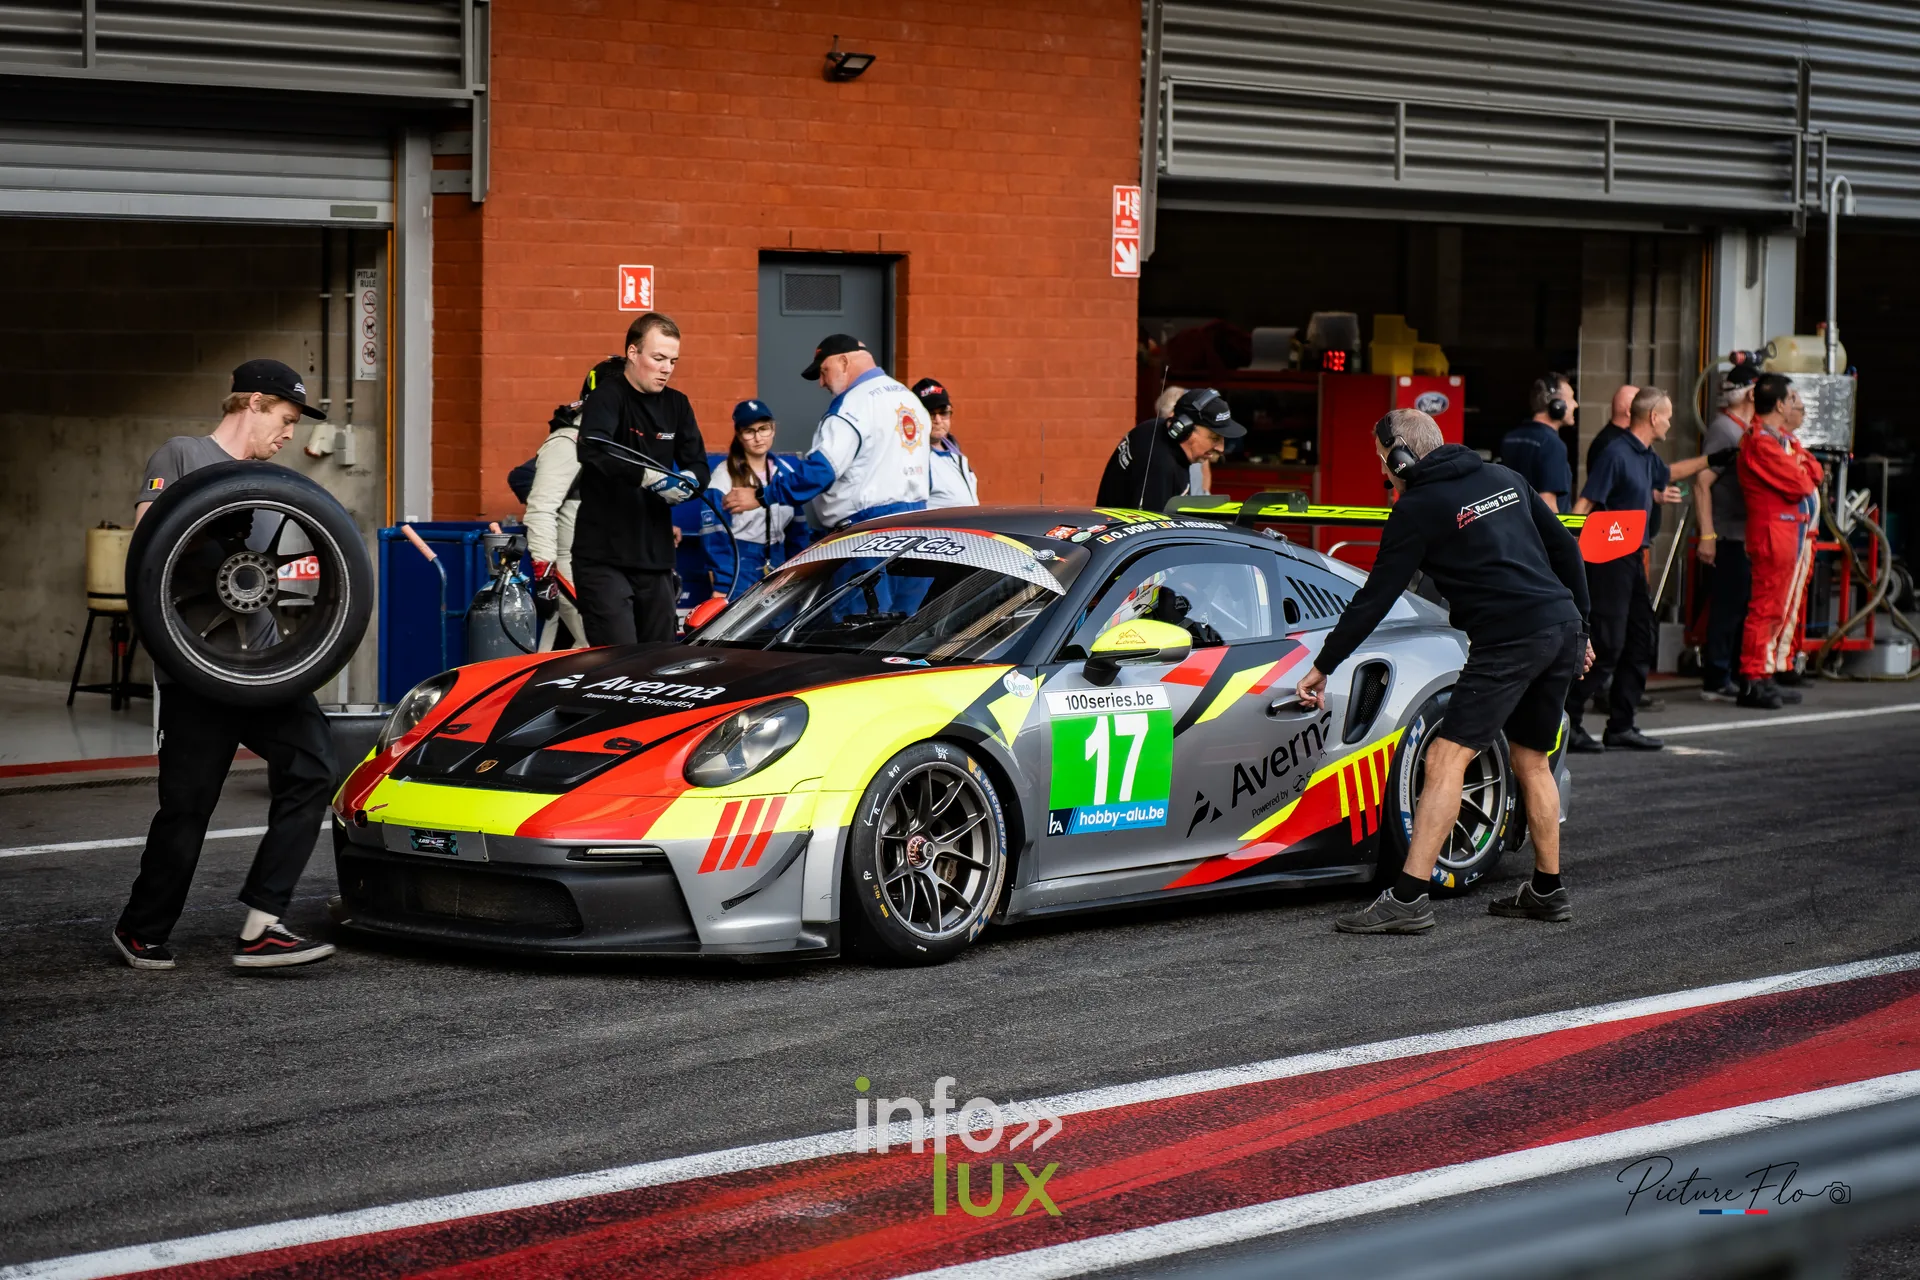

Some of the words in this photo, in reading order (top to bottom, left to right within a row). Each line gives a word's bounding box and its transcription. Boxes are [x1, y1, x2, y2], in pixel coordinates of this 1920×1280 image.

[1474, 499, 1500, 513] Racing
[1498, 491, 1519, 504] Team
[1127, 522, 1157, 536] DONS
[581, 675, 727, 701] Averna
[1065, 690, 1154, 711] 100series.be
[1084, 712, 1150, 806] 17
[982, 777, 1007, 850] MICHELIN
[1251, 792, 1280, 818] Powered
[1280, 788, 1290, 801] by
[1079, 805, 1165, 828] hobby-alu.be
